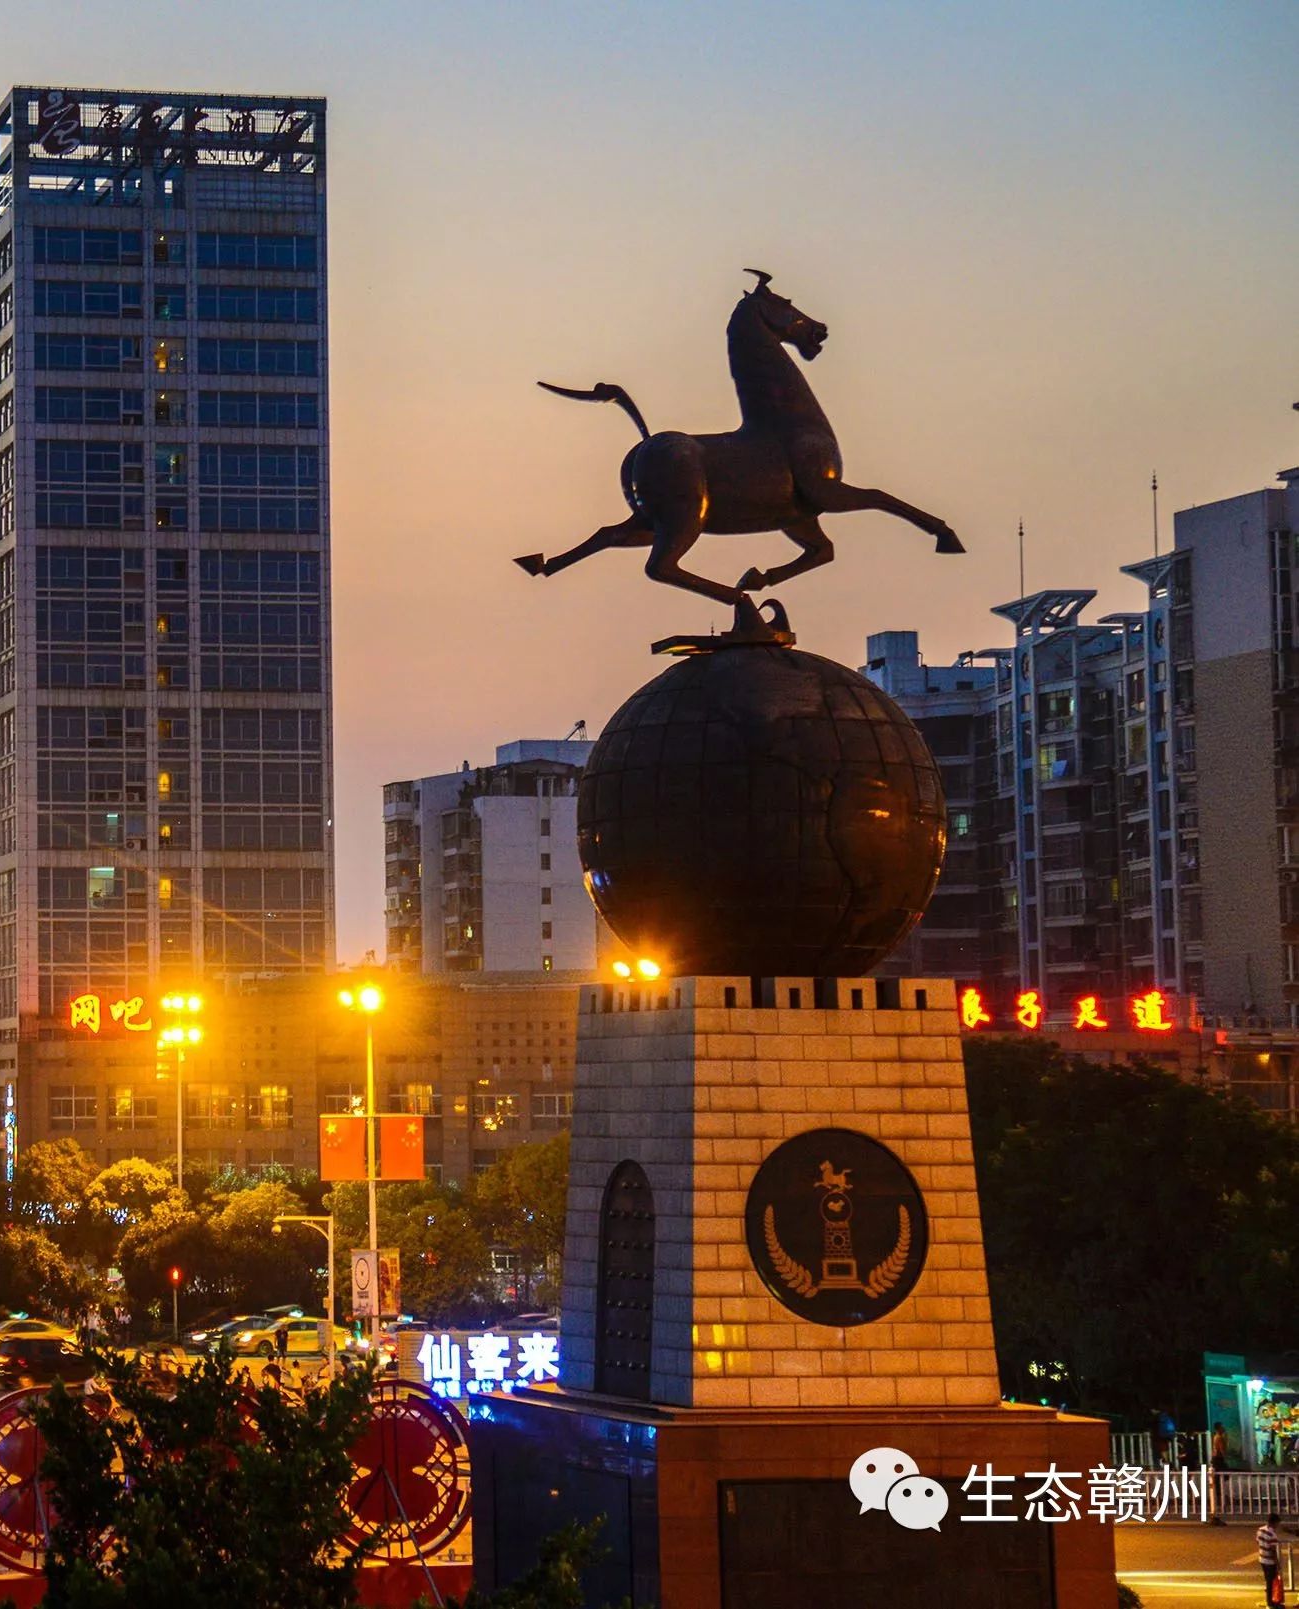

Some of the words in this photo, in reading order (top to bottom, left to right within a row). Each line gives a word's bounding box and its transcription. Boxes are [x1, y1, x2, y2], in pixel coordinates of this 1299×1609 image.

[69, 994, 153, 1034] 网吧
[416, 1331, 560, 1382] 仙客来
